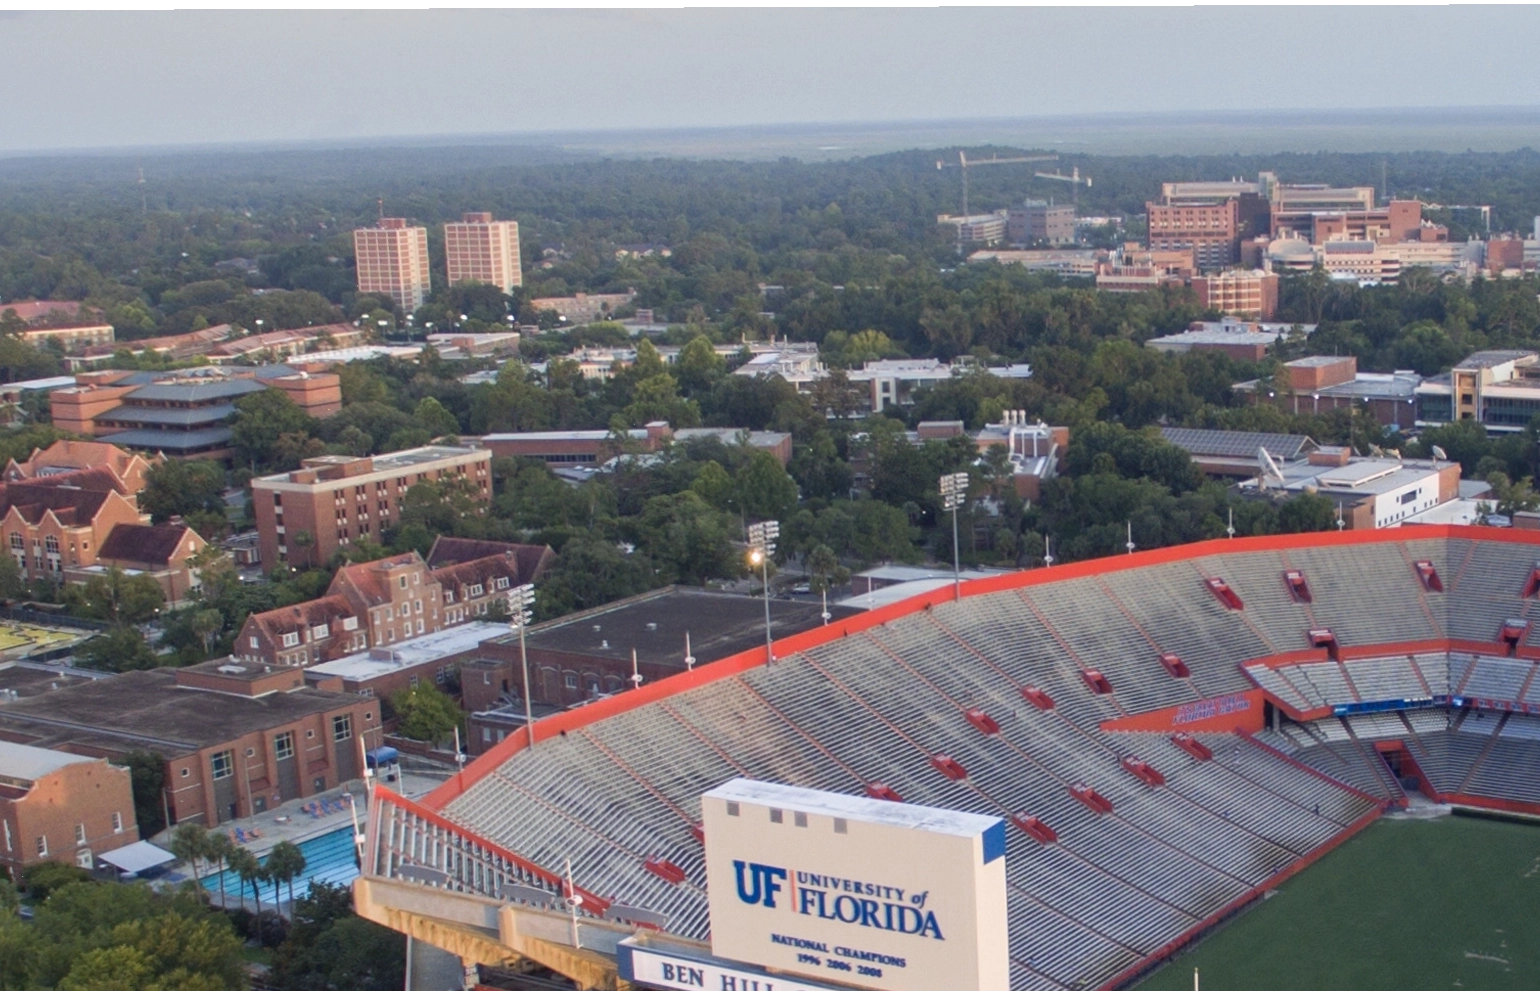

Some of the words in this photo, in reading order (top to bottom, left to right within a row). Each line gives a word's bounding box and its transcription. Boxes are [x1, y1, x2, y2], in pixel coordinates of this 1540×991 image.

[733, 860, 787, 908] UF
[796, 871, 905, 900] UNIVERSITY
[912, 890, 929, 909] of
[796, 886, 945, 940] FLORIDA
[770, 933, 829, 954] NATIONAL
[834, 945, 906, 969] CHAMPIONS
[797, 952, 821, 967] 1996
[826, 957, 852, 973] 2006
[857, 963, 883, 979] 2008
[662, 962, 705, 988] BEN
